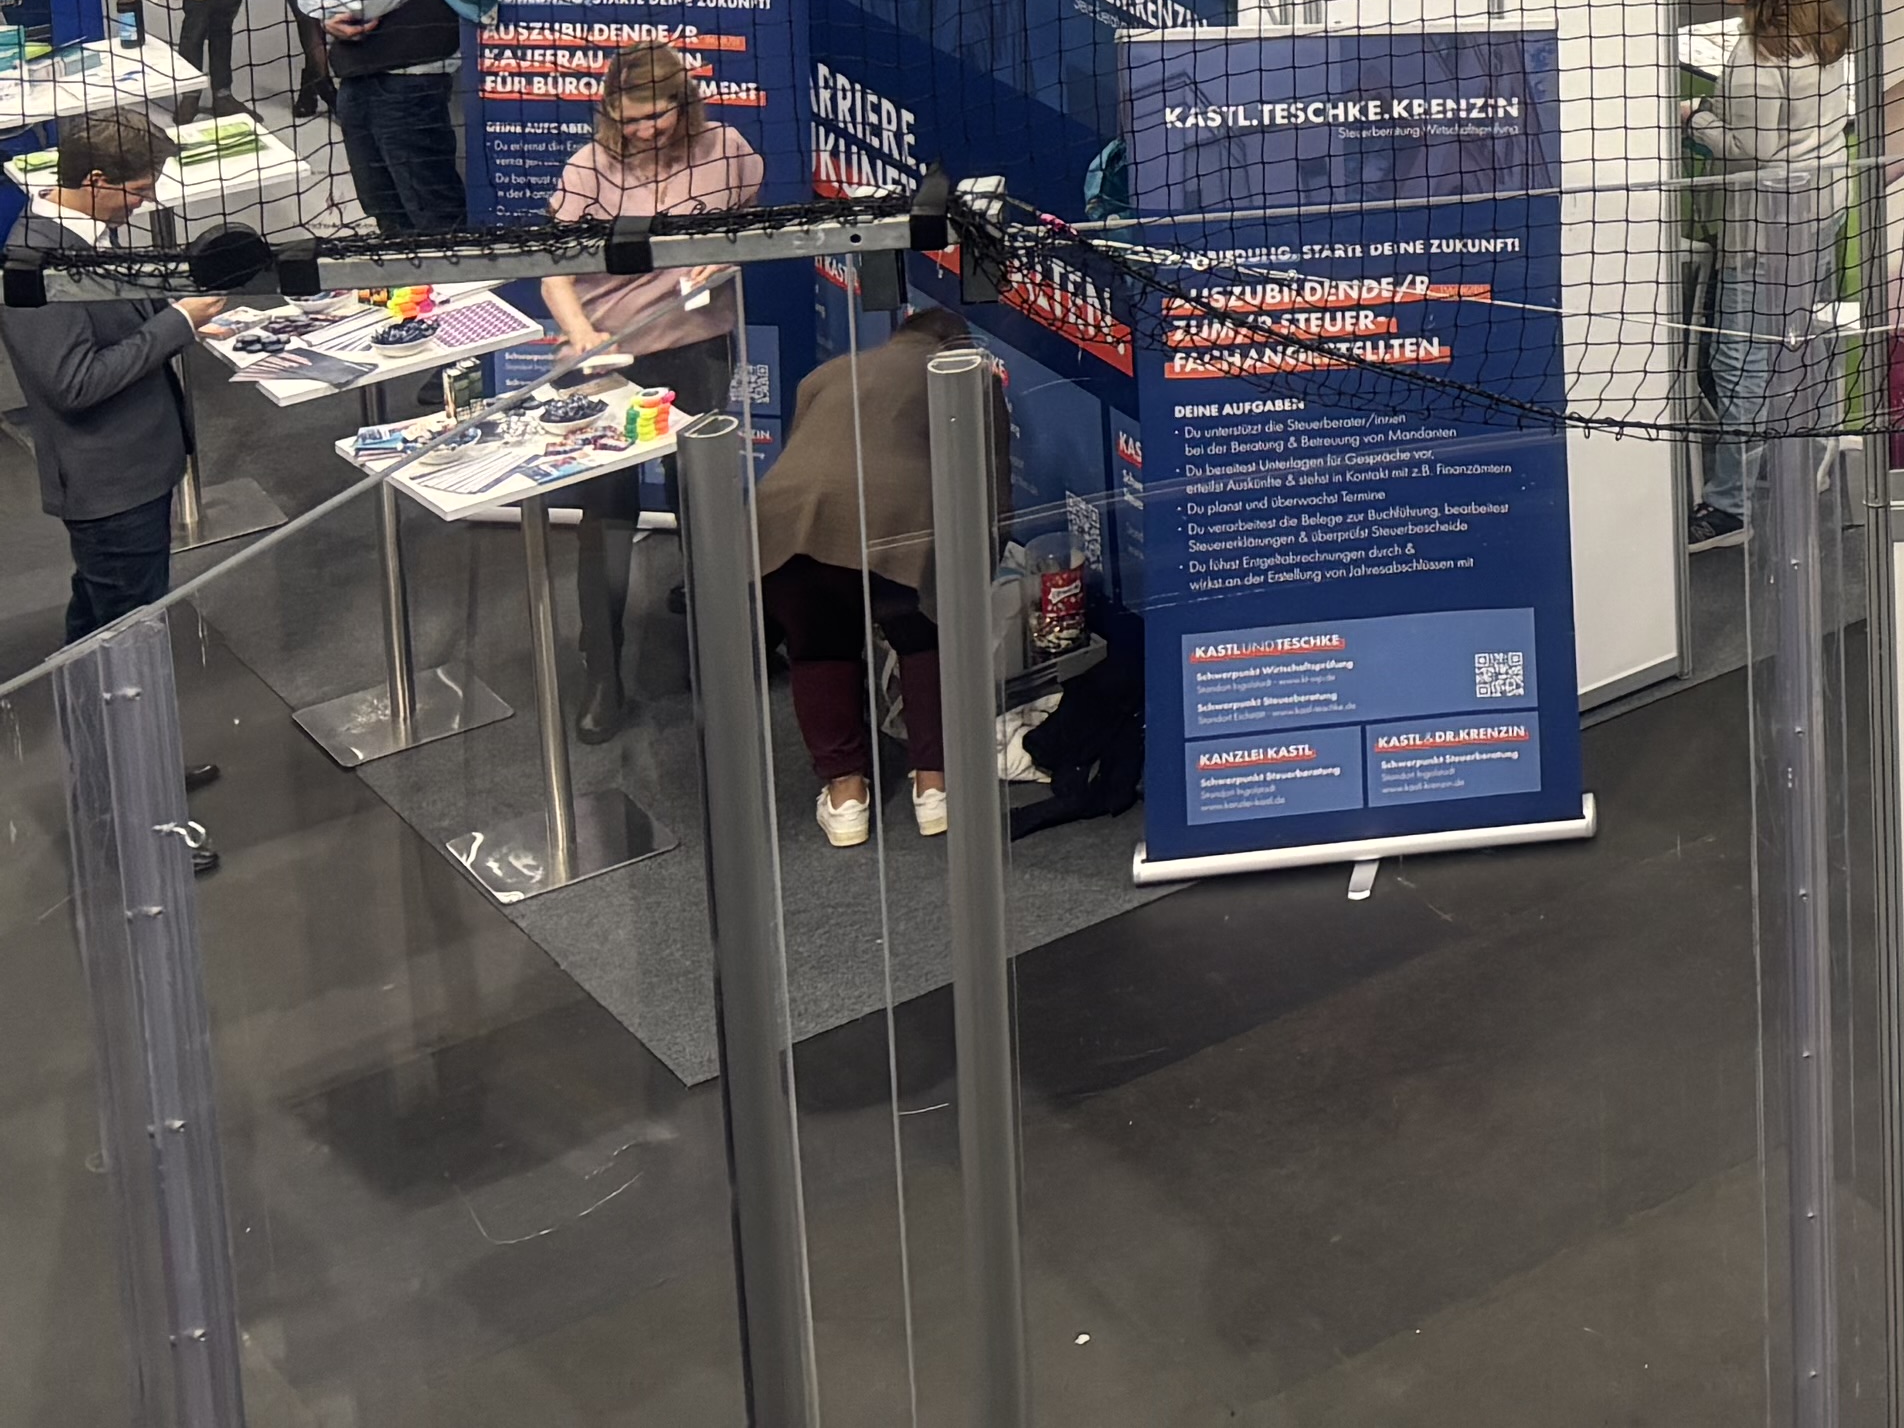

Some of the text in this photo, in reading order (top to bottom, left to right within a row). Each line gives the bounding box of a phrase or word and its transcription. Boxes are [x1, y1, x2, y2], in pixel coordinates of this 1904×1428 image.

[1165, 97, 1519, 129] KASTL.TESCHKE.KRENZIN
[1370, 240, 1424, 256] DEINE
[1430, 238, 1520, 254] ZUKUNFT!
[1174, 398, 1305, 419] DEINE AUFGABEN
[1246, 497, 1268, 510] und
[1341, 490, 1386, 502] Termine
[1200, 745, 1313, 765] KANZLEI KASTL
